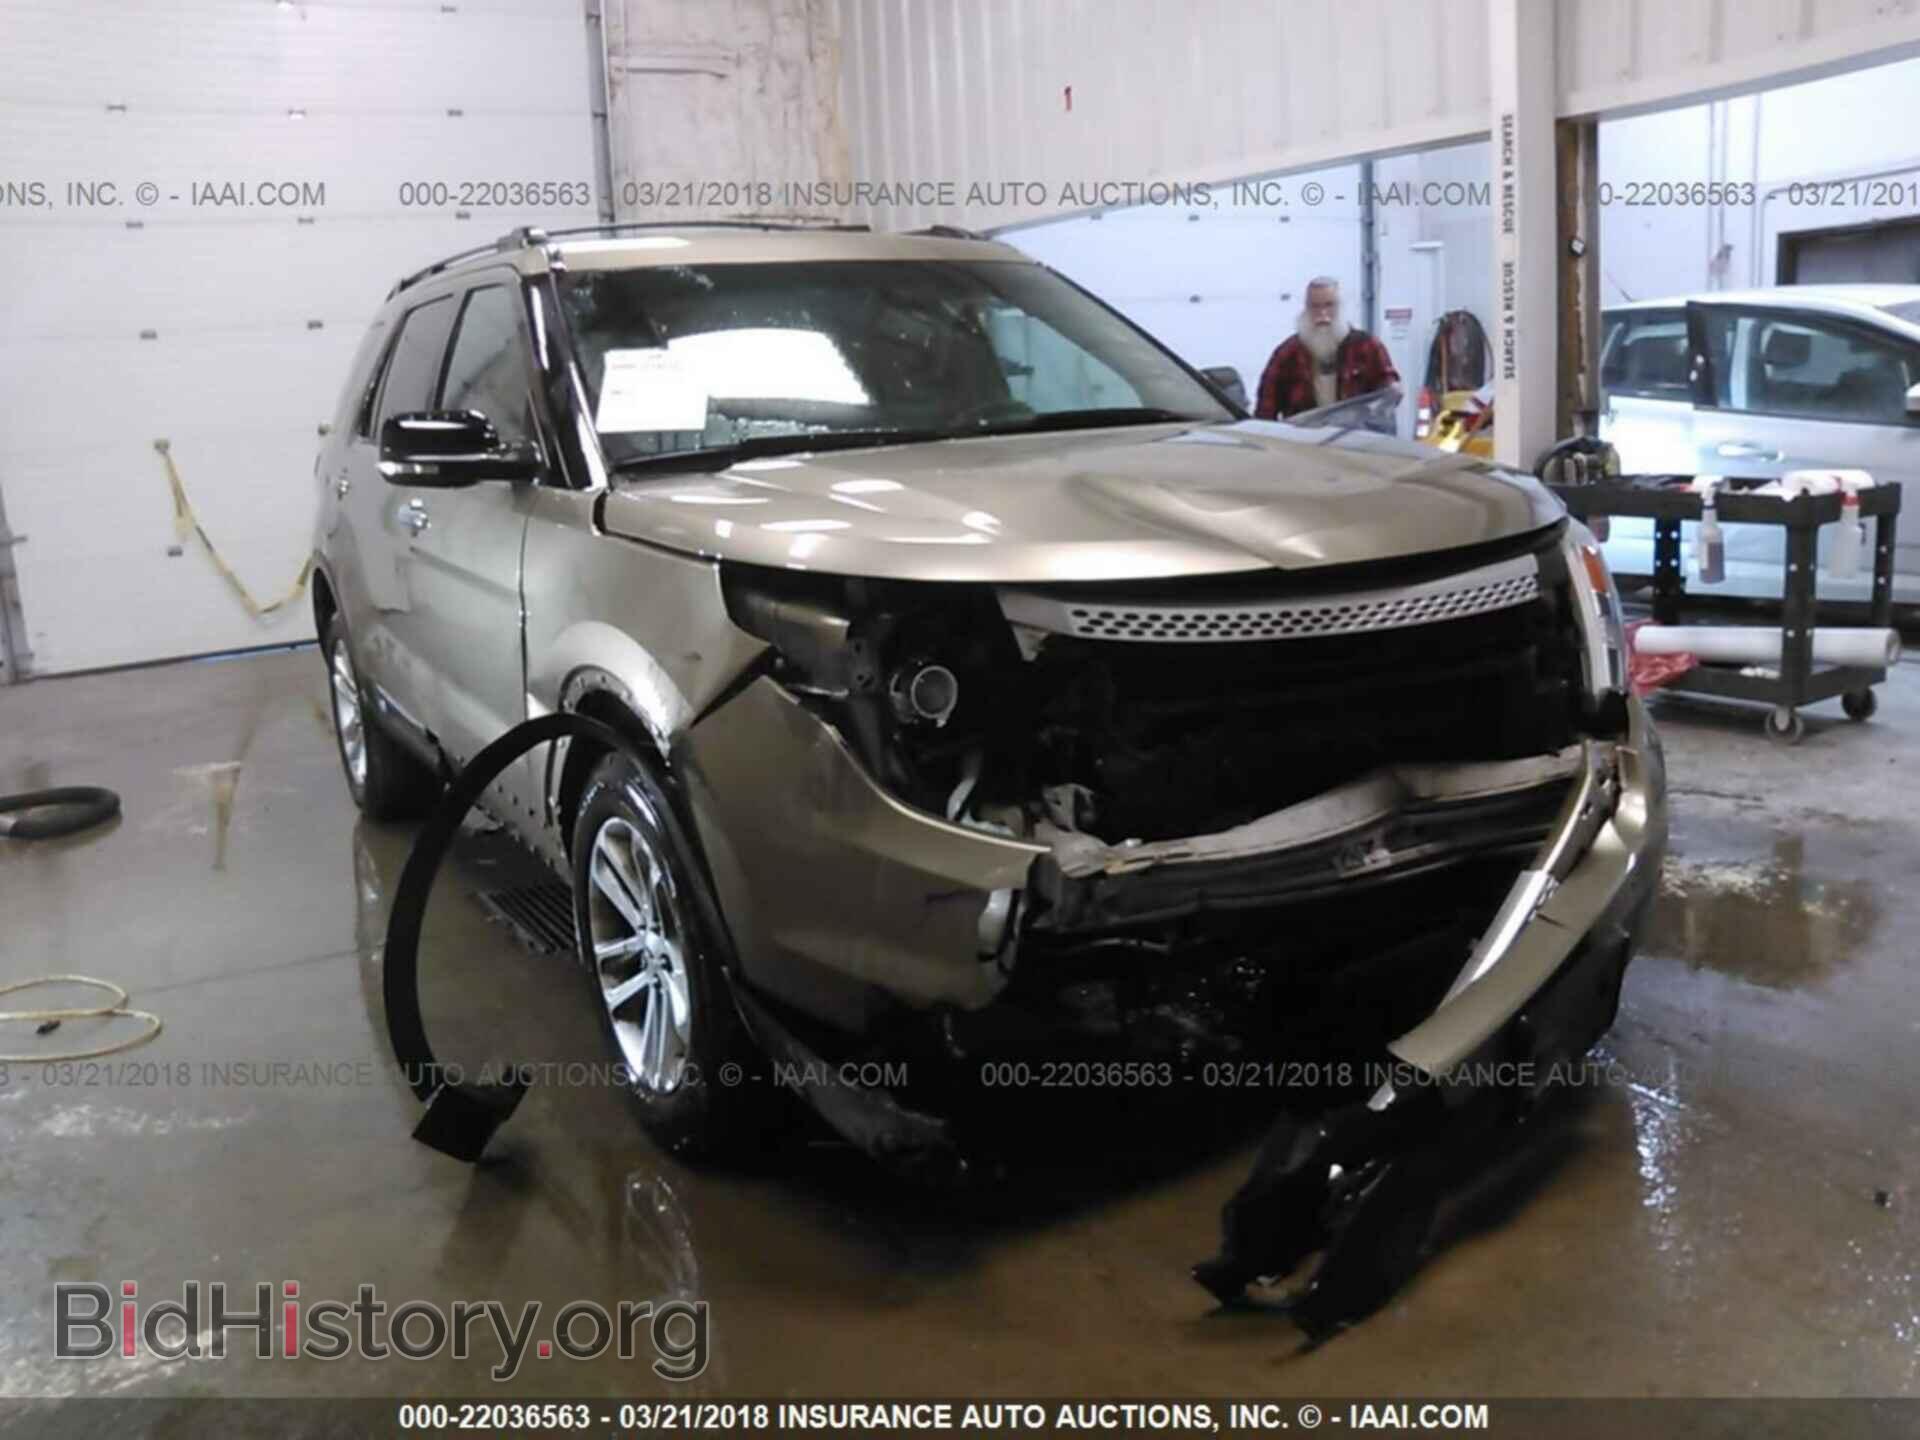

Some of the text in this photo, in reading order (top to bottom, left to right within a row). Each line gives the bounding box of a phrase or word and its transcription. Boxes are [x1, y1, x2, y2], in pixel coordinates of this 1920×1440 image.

[1502, 115, 1513, 165] SEARCH
[1503, 184, 1514, 232] RESCUE
[1503, 262, 1515, 311] RESCUE
[1503, 329, 1515, 379] SEARCH
